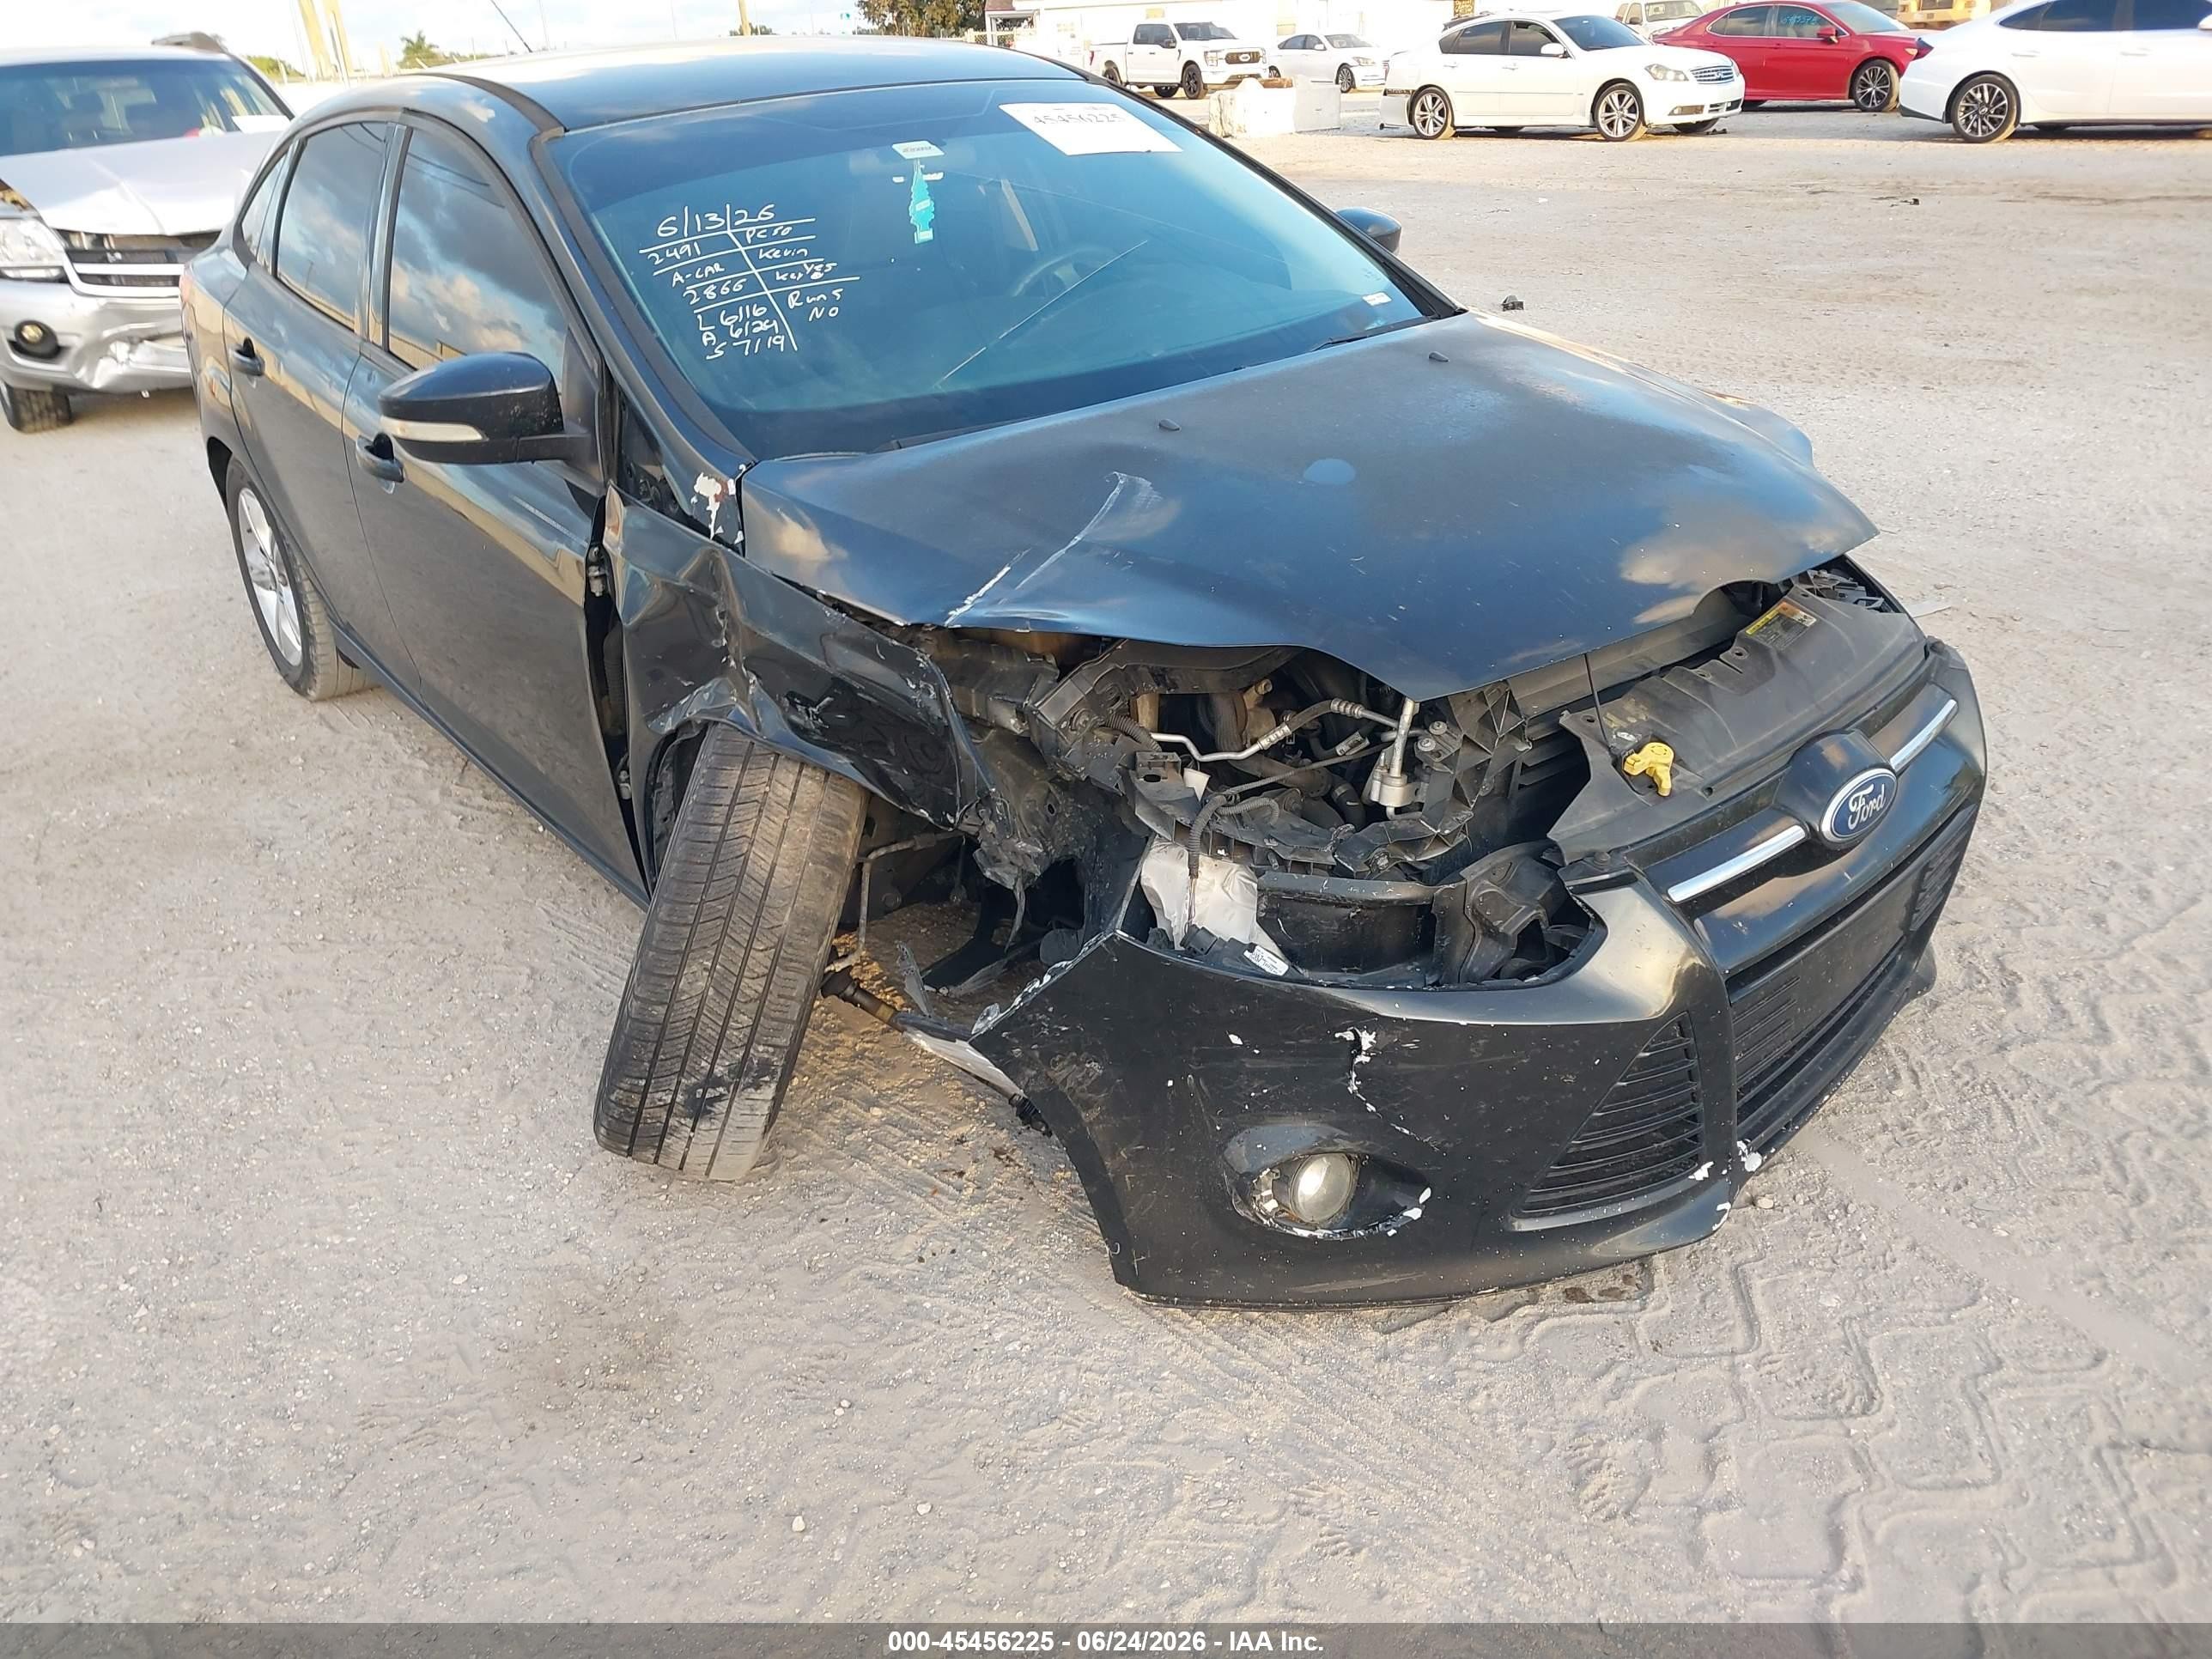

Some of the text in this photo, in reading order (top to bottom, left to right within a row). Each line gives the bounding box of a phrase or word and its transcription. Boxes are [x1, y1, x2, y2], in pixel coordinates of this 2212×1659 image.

[647, 241, 702, 265] 2491
[683, 278, 747, 306] 2866
[697, 314, 715, 331] L
[702, 331, 716, 347] A
[1847, 782, 1887, 831] Ford
